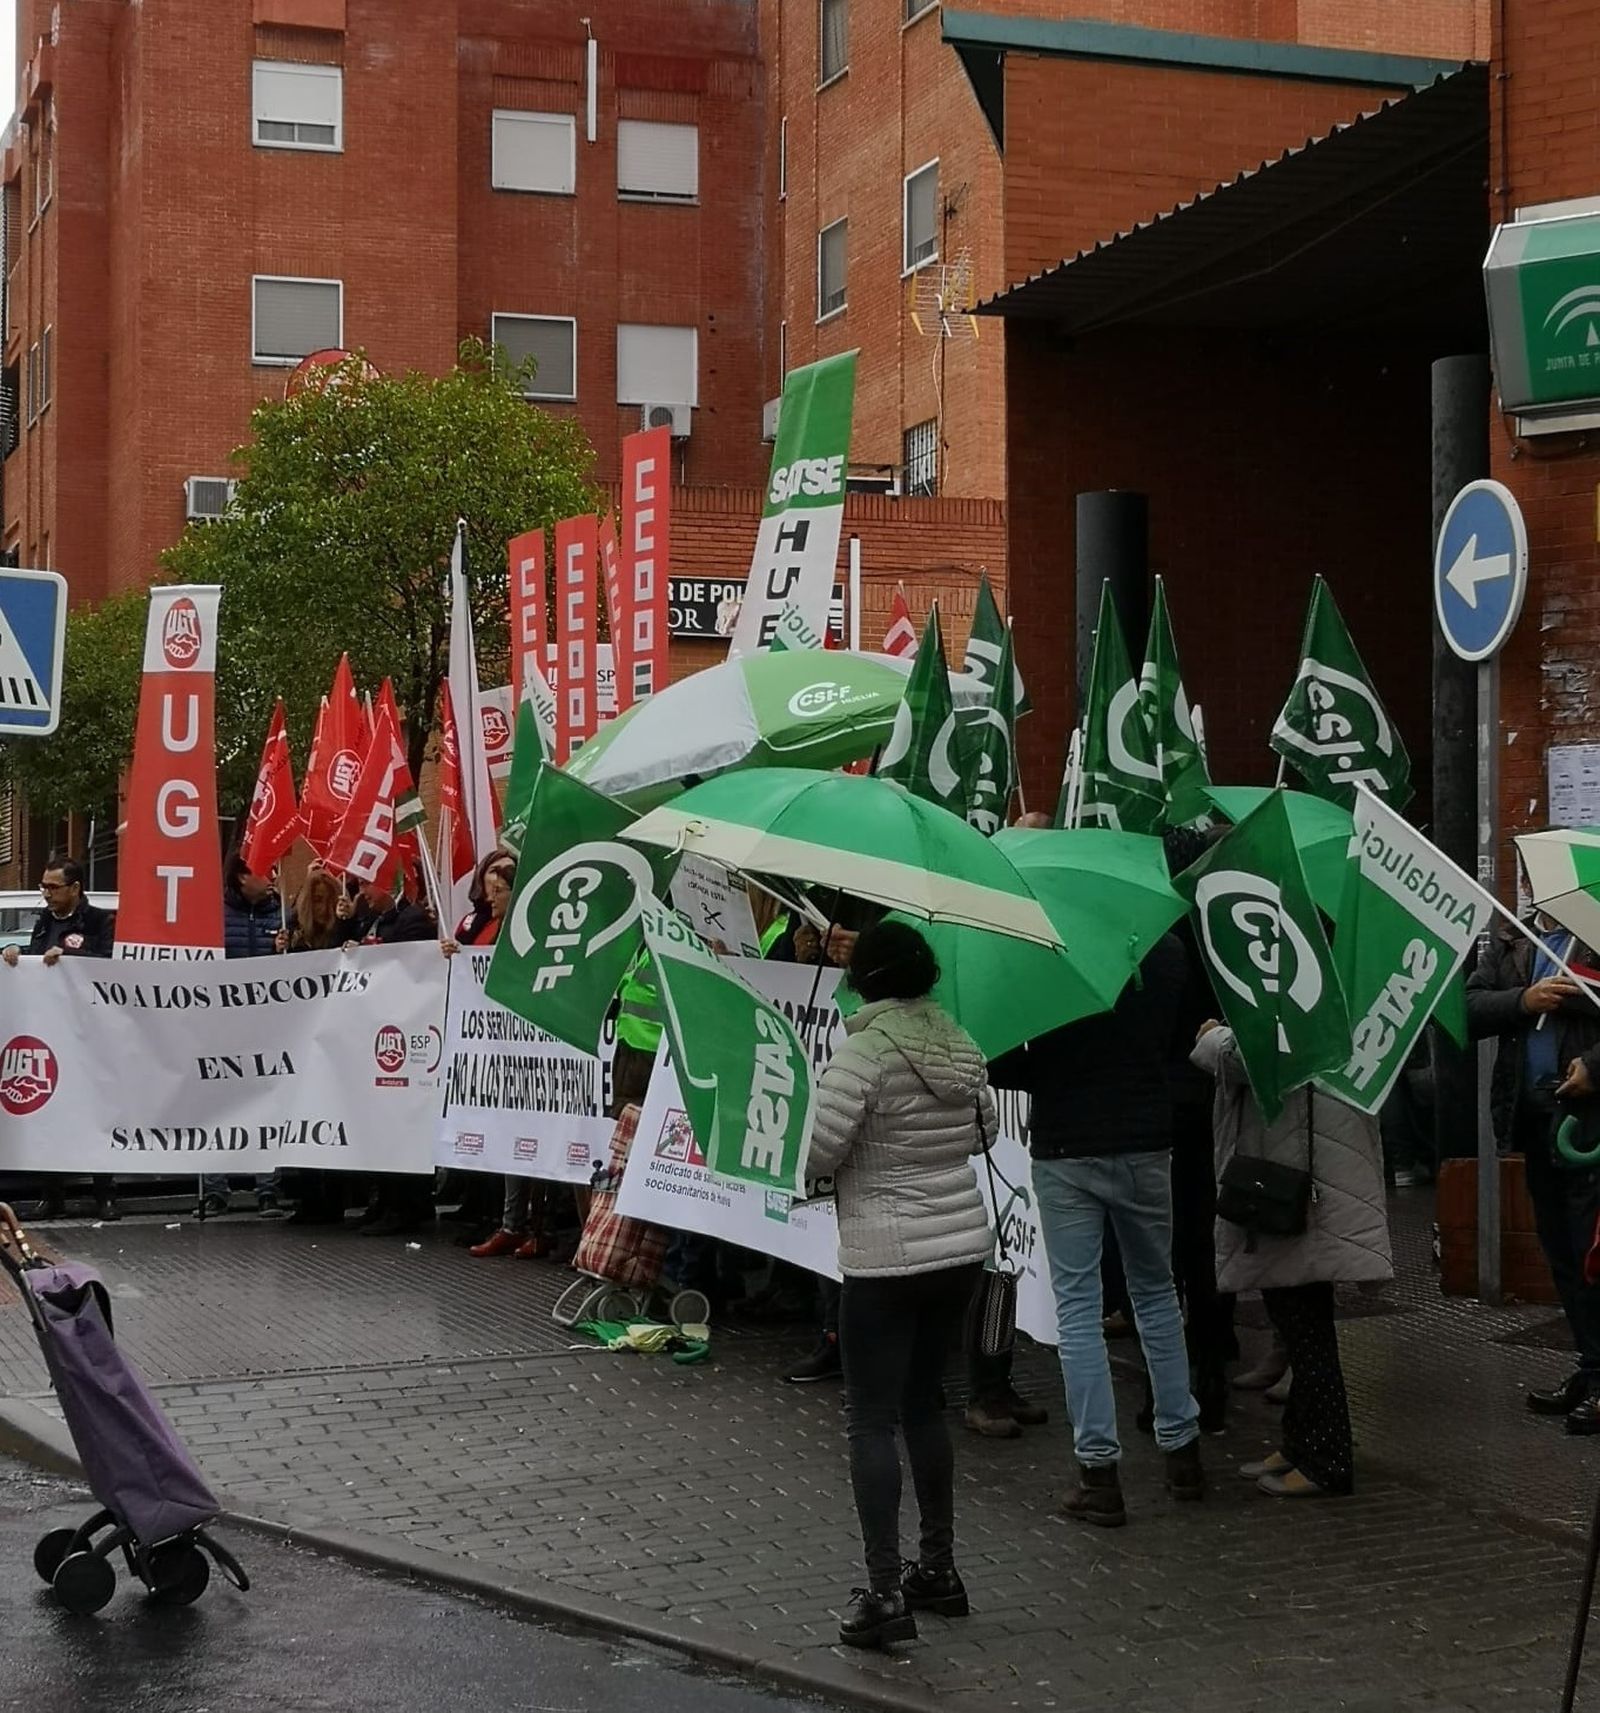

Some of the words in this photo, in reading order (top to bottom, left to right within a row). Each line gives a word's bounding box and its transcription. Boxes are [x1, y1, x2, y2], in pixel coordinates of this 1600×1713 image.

[633, 457, 655, 653] CCOO
[680, 584, 704, 602] DE
[169, 609, 197, 637] UGT
[566, 542, 585, 728] CCOO
[597, 669, 615, 682] SP
[156, 694, 200, 923] UGT
[92, 981, 127, 1006] NO
[134, 985, 147, 1007] A
[152, 984, 211, 1009] LOS
[461, 1010, 485, 1039] LOS
[379, 1032, 403, 1051] UGT
[2, 1048, 50, 1079] UGT
[197, 1055, 243, 1080] EN
[253, 1051, 295, 1077] LA
[470, 1054, 478, 1106] A
[480, 1054, 500, 1109] LOS
[502, 1055, 547, 1112] RECORTES
[547, 1057, 559, 1113] DE
[111, 1126, 249, 1151] SANIDAD
[650, 1159, 691, 1180] sindicato
